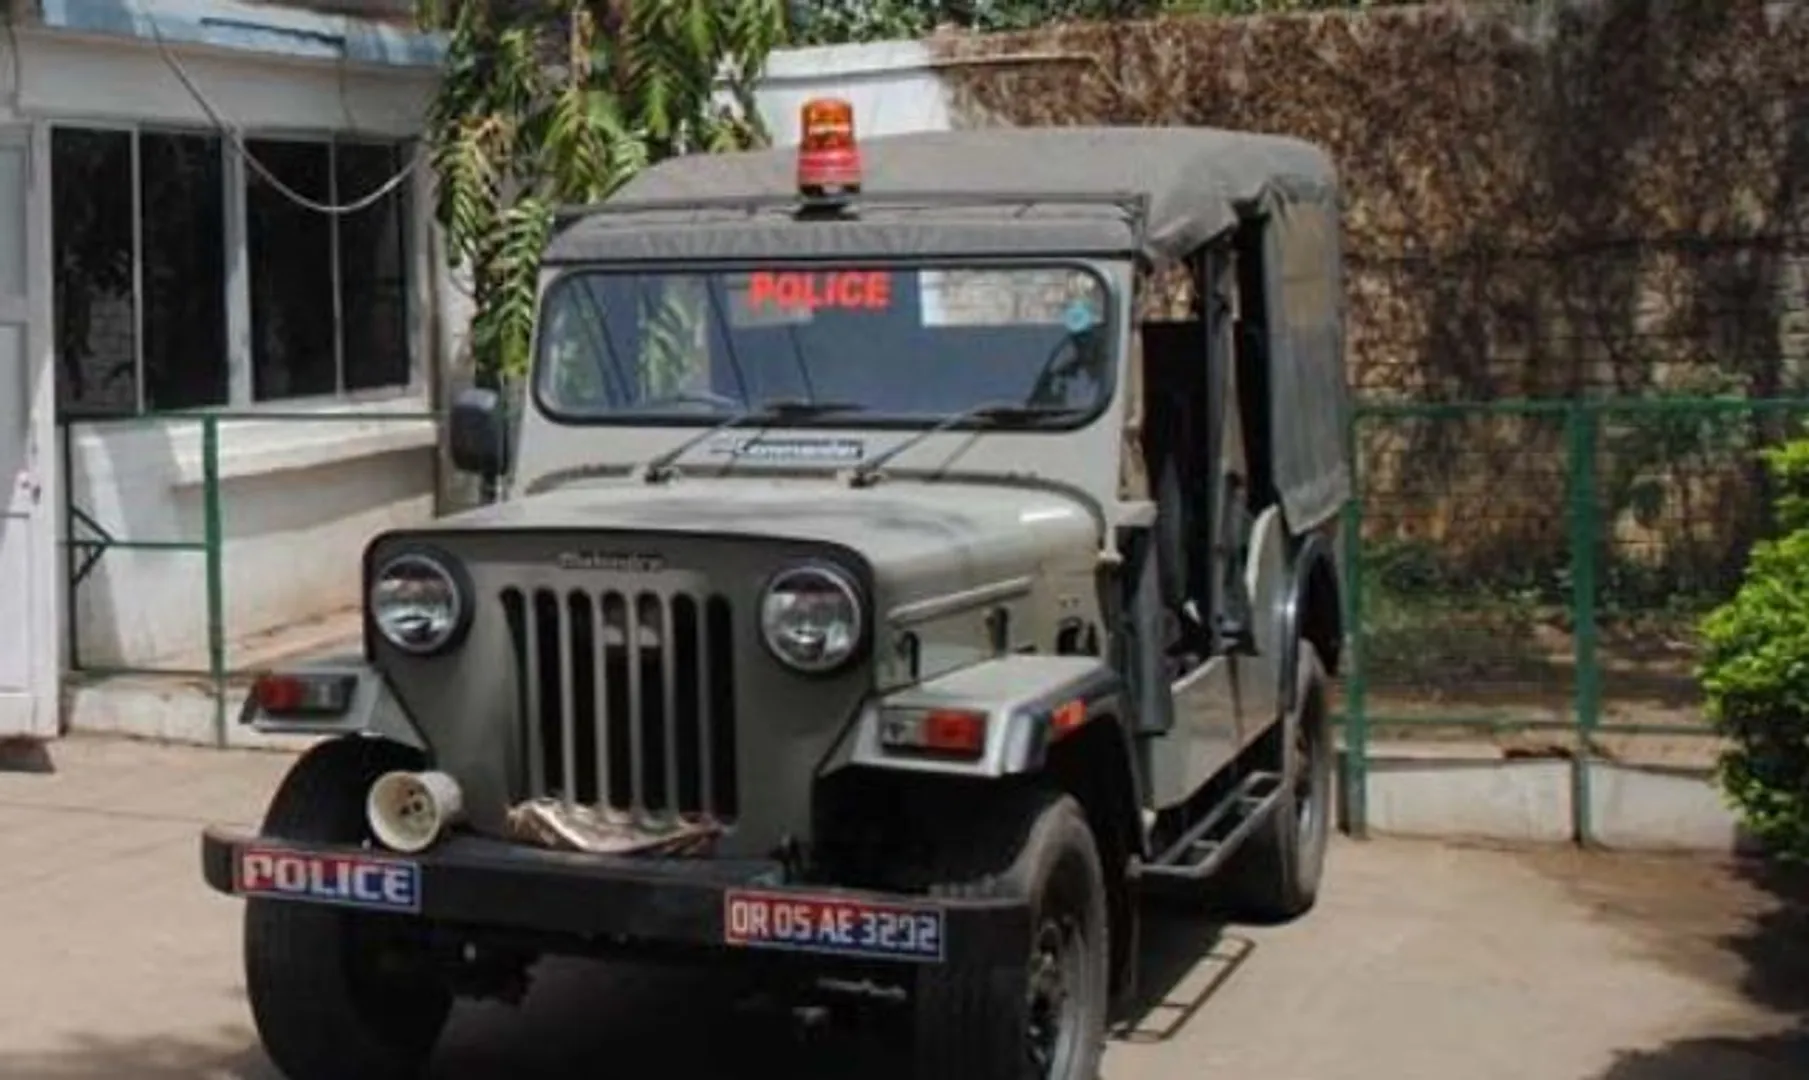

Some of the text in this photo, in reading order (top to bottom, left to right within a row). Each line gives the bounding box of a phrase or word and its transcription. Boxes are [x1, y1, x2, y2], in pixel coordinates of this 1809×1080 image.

[749, 270, 890, 307] POLICE
[242, 854, 411, 904] POLICE
[774, 903, 812, 940] 05
[818, 905, 853, 943] AE
